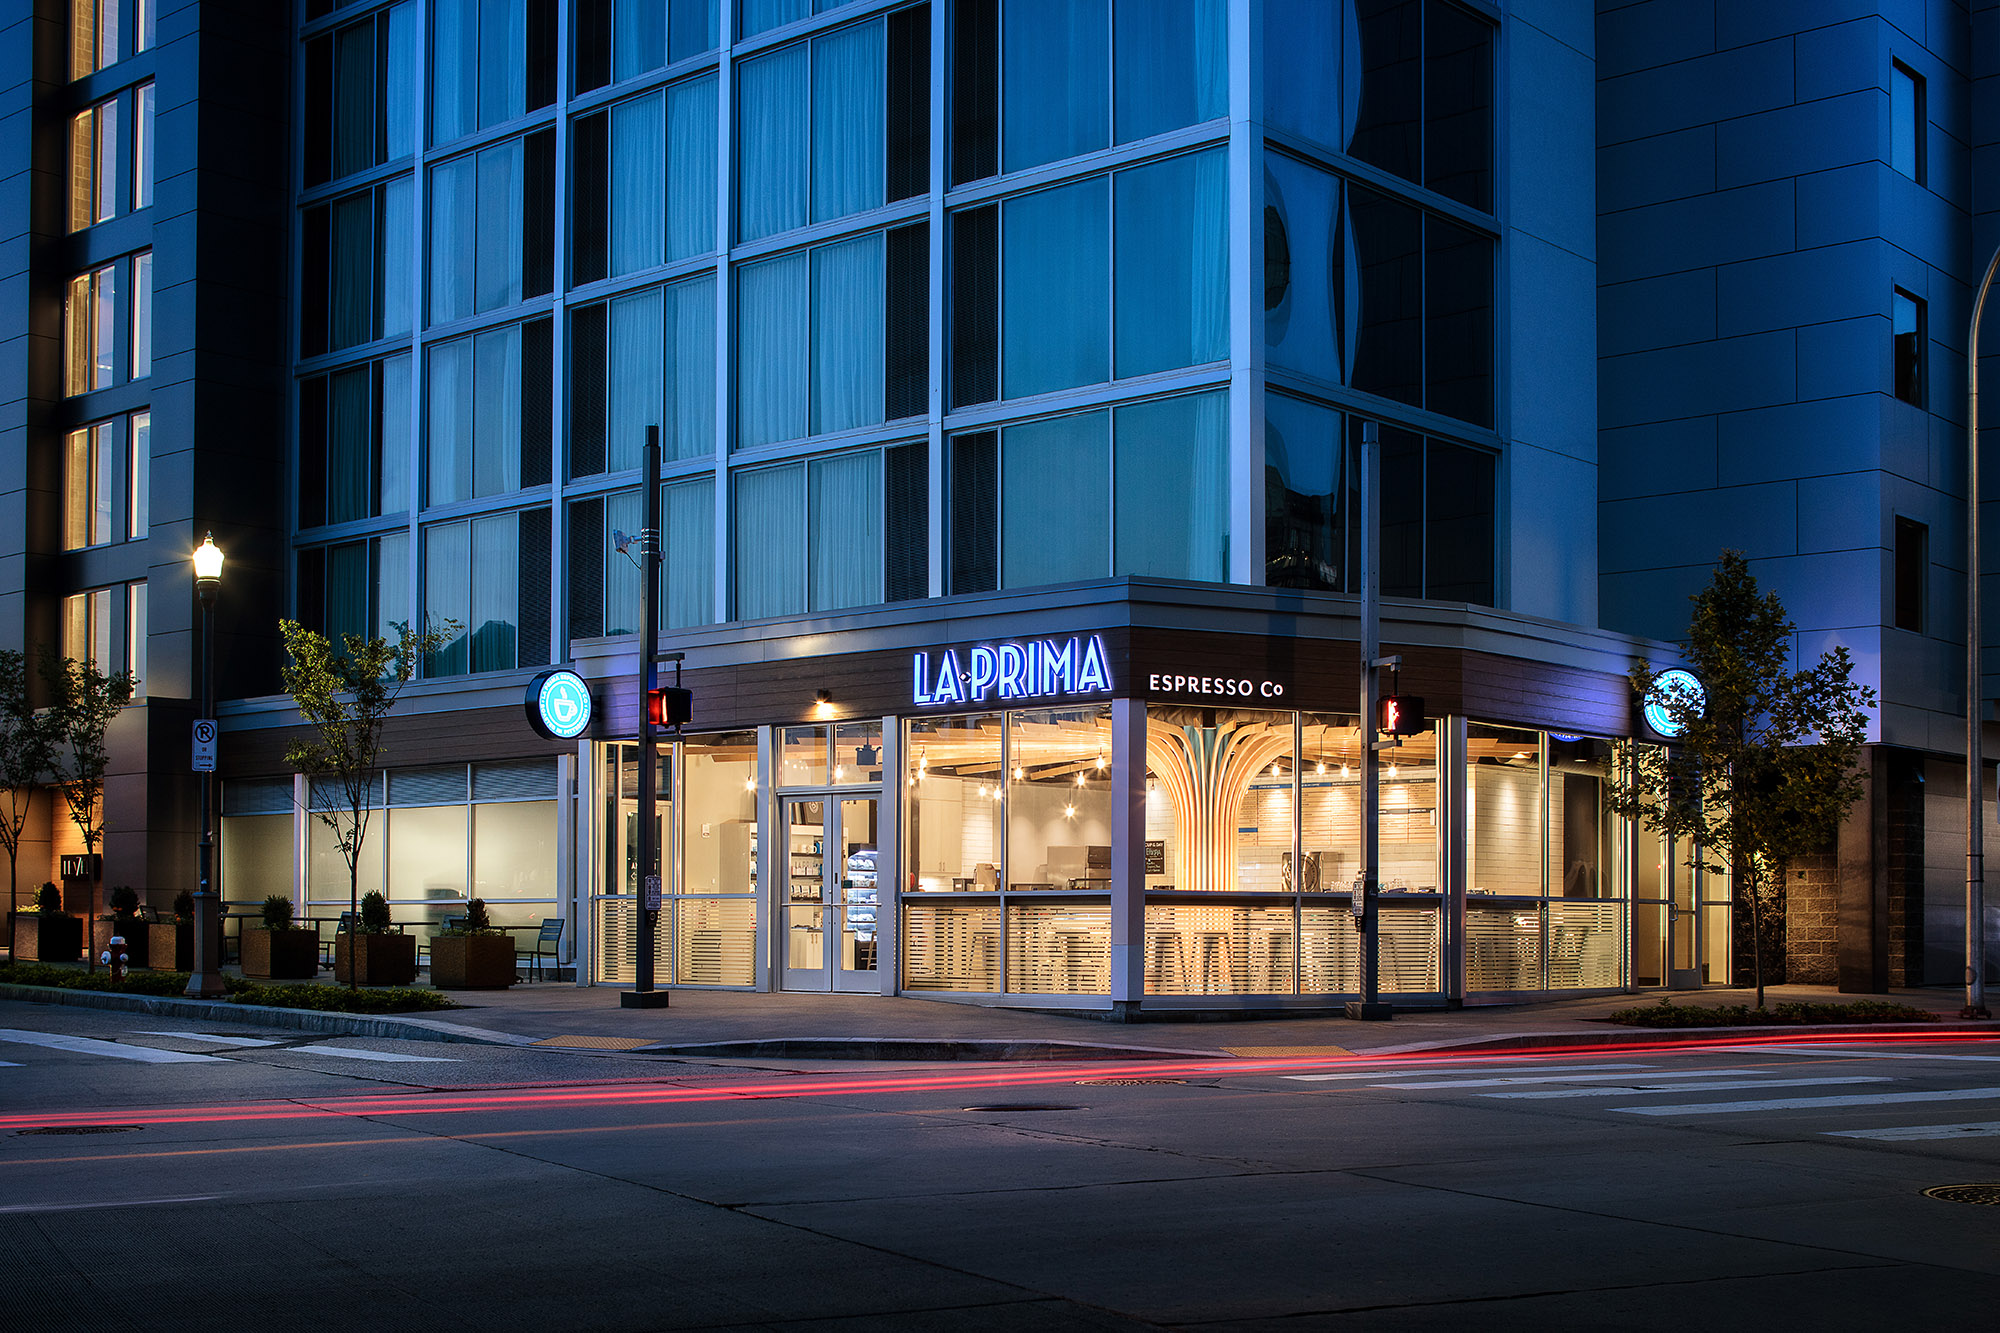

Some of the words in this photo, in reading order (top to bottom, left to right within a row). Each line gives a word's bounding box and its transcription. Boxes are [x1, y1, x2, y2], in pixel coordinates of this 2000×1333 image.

[913, 648, 966, 706] LA
[970, 634, 1112, 702] PRIMA
[545, 675, 560, 690] PRIMA
[560, 674, 585, 694] ESPRESSO
[1149, 673, 1254, 697] ESPRESSO
[1260, 681, 1284, 698] Co
[564, 708, 588, 734] PITTSBURGH
[1646, 706, 1664, 731] ROASTED
